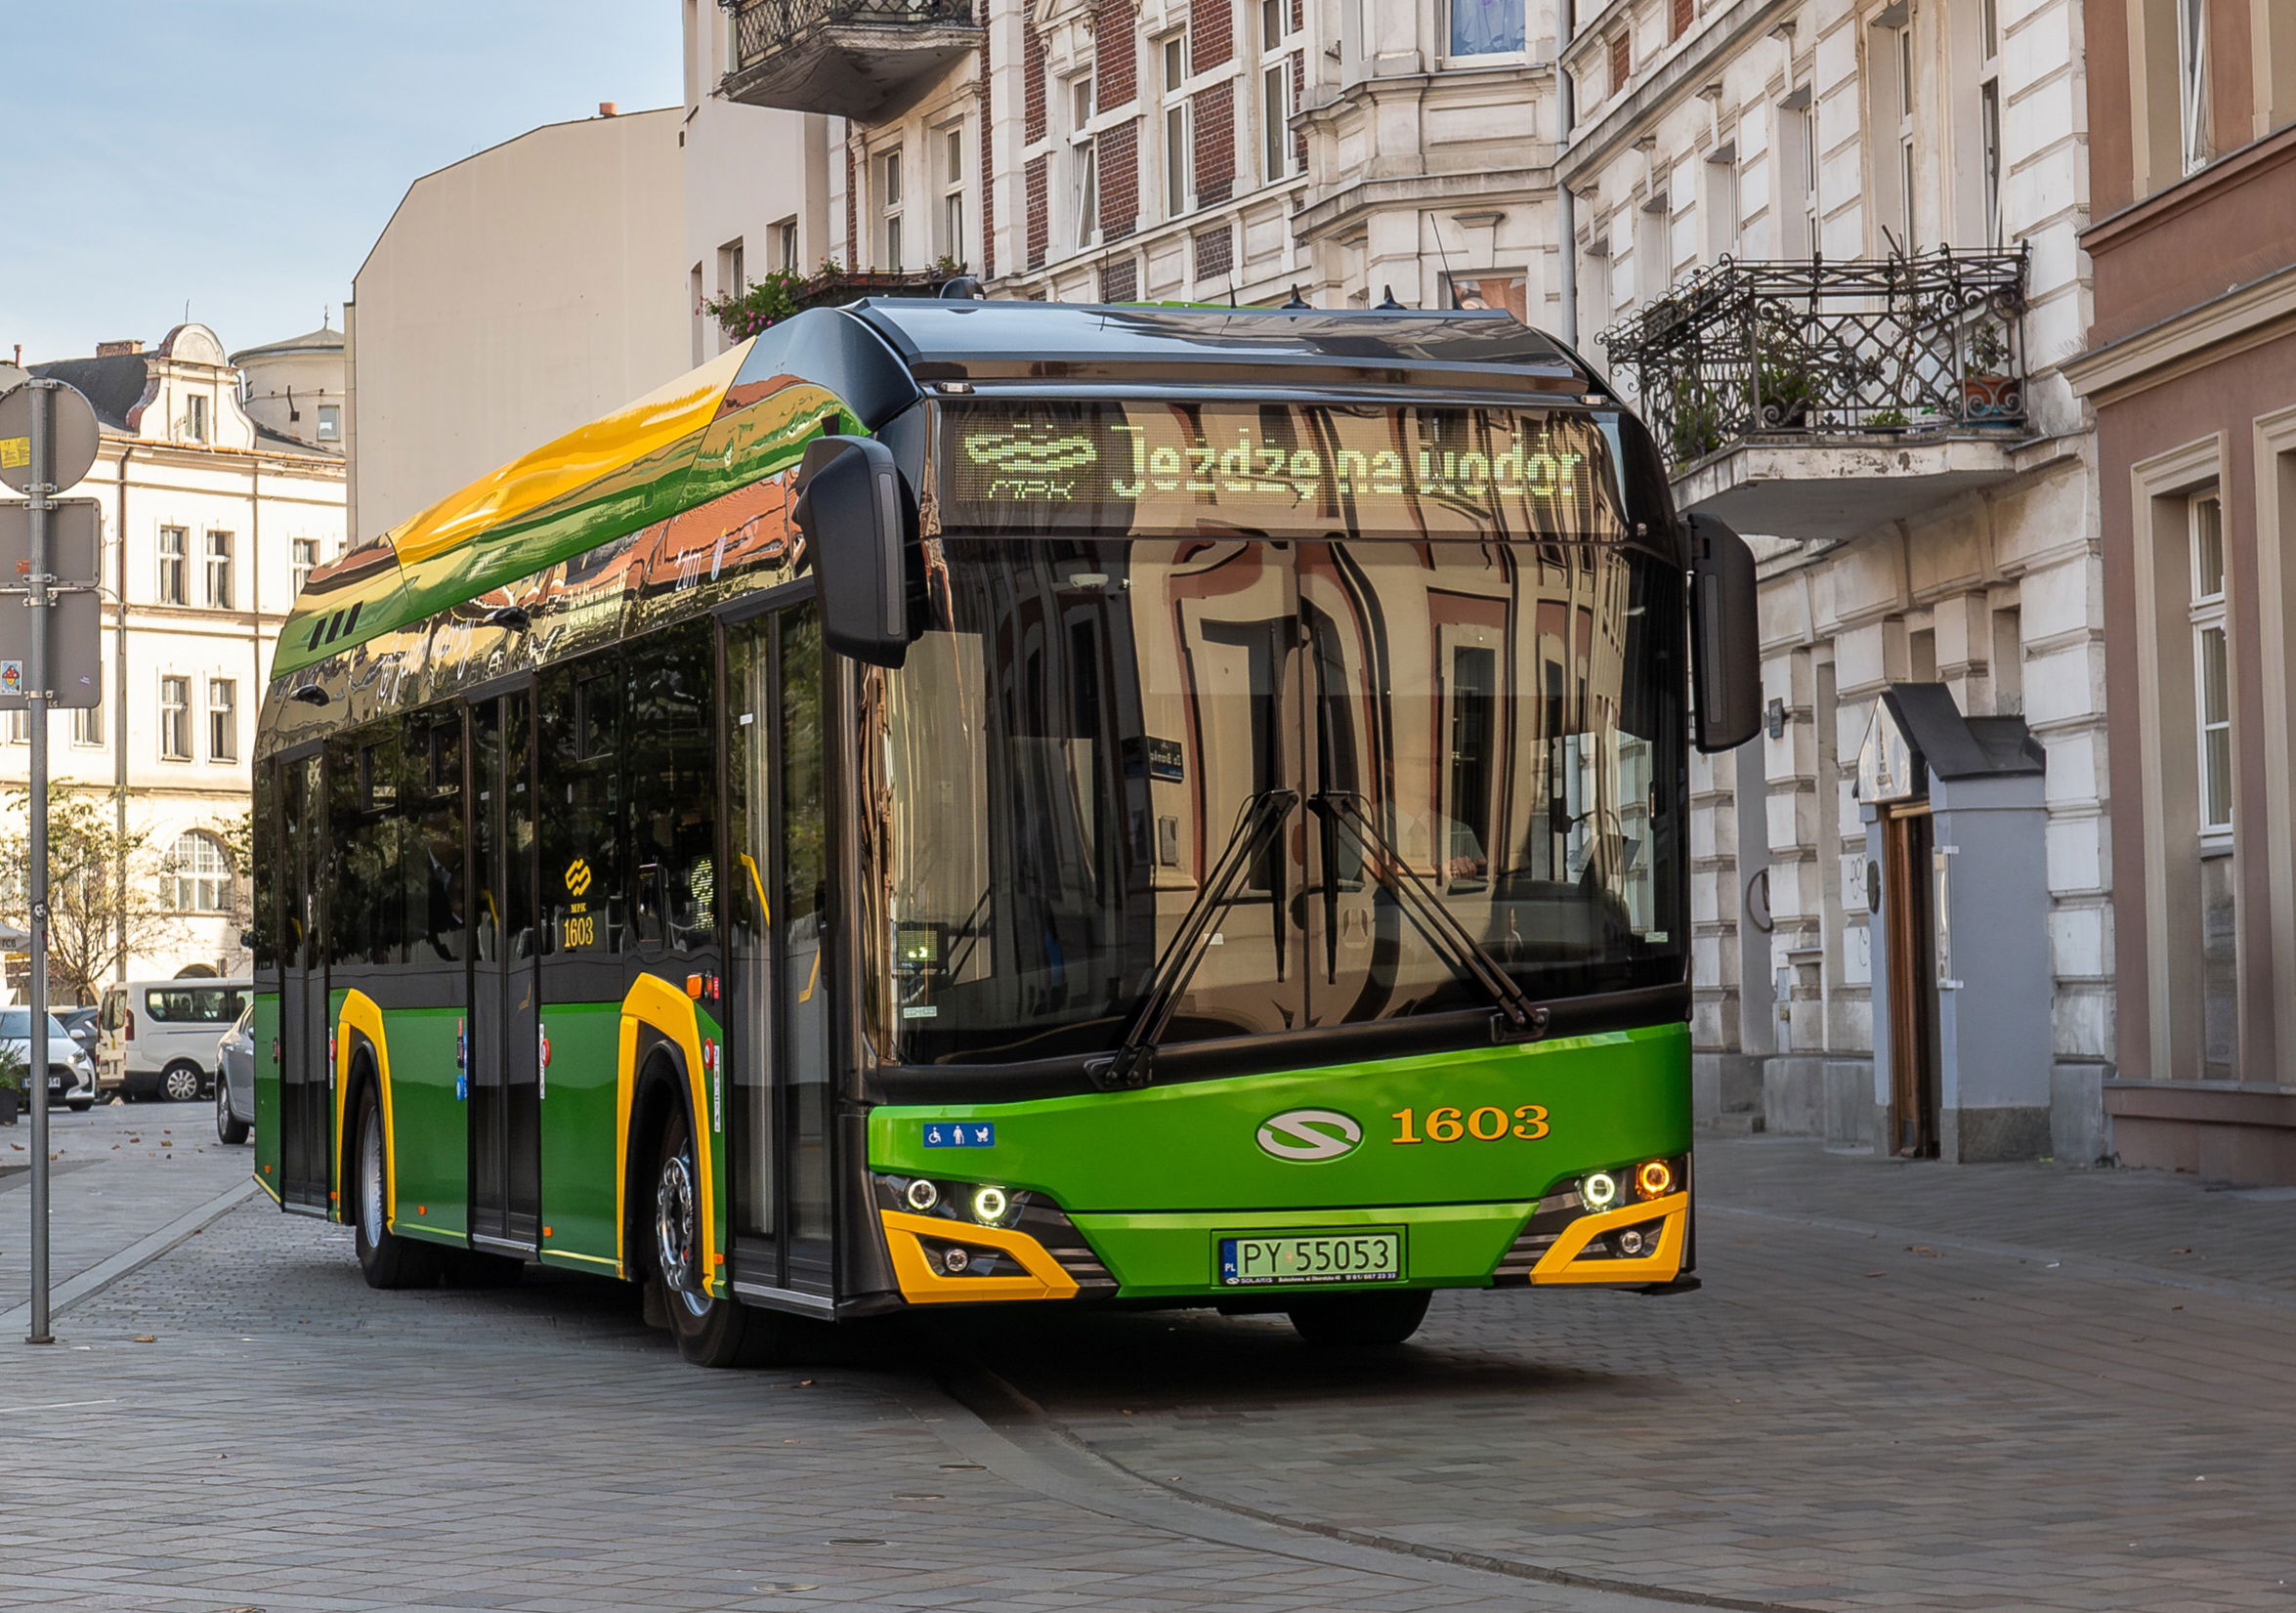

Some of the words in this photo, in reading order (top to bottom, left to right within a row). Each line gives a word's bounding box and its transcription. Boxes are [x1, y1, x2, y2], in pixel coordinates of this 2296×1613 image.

[1338, 450, 1403, 494] na
[570, 902, 586, 913] MPK
[564, 915, 593, 948] 1603
[1391, 1104, 1551, 1144] 1603
[1224, 1262, 1236, 1272] PL
[1244, 1242, 1282, 1274] PY
[1296, 1239, 1389, 1272] 55053
